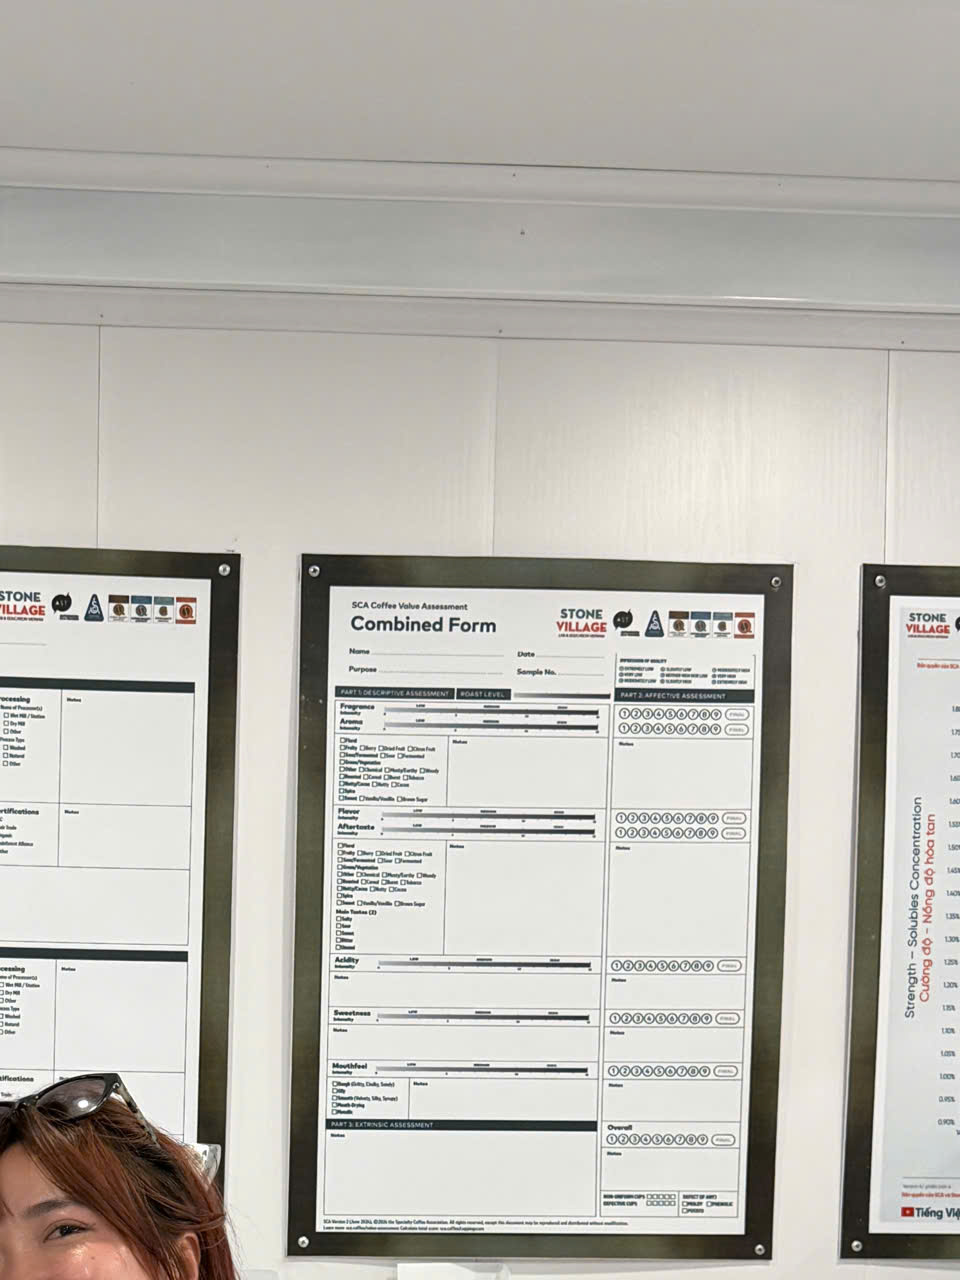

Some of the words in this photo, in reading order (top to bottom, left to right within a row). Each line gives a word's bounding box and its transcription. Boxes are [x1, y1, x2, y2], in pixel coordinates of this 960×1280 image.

[371, 601, 397, 610] Coffee
[421, 603, 468, 611] Assessment
[560, 609, 603, 619] STONE
[909, 613, 946, 622] STONE
[351, 616, 443, 632] Combined
[449, 617, 496, 633] Form
[557, 622, 607, 633] VILLAGE
[906, 624, 950, 634] VILLAGE
[340, 703, 375, 711] Fragrance
[927, 814, 935, 835] tan
[910, 796, 922, 890] Concentration
[924, 839, 935, 865] hòa
[924, 867, 935, 886] độ
[907, 894, 919, 947] Solubles
[922, 938, 933, 956] độ
[335, 957, 359, 965] Acidity
[905, 962, 917, 1018] Strength
[916, 1206, 943, 1220] Tiếng
[945, 1208, 960, 1220] Việ
